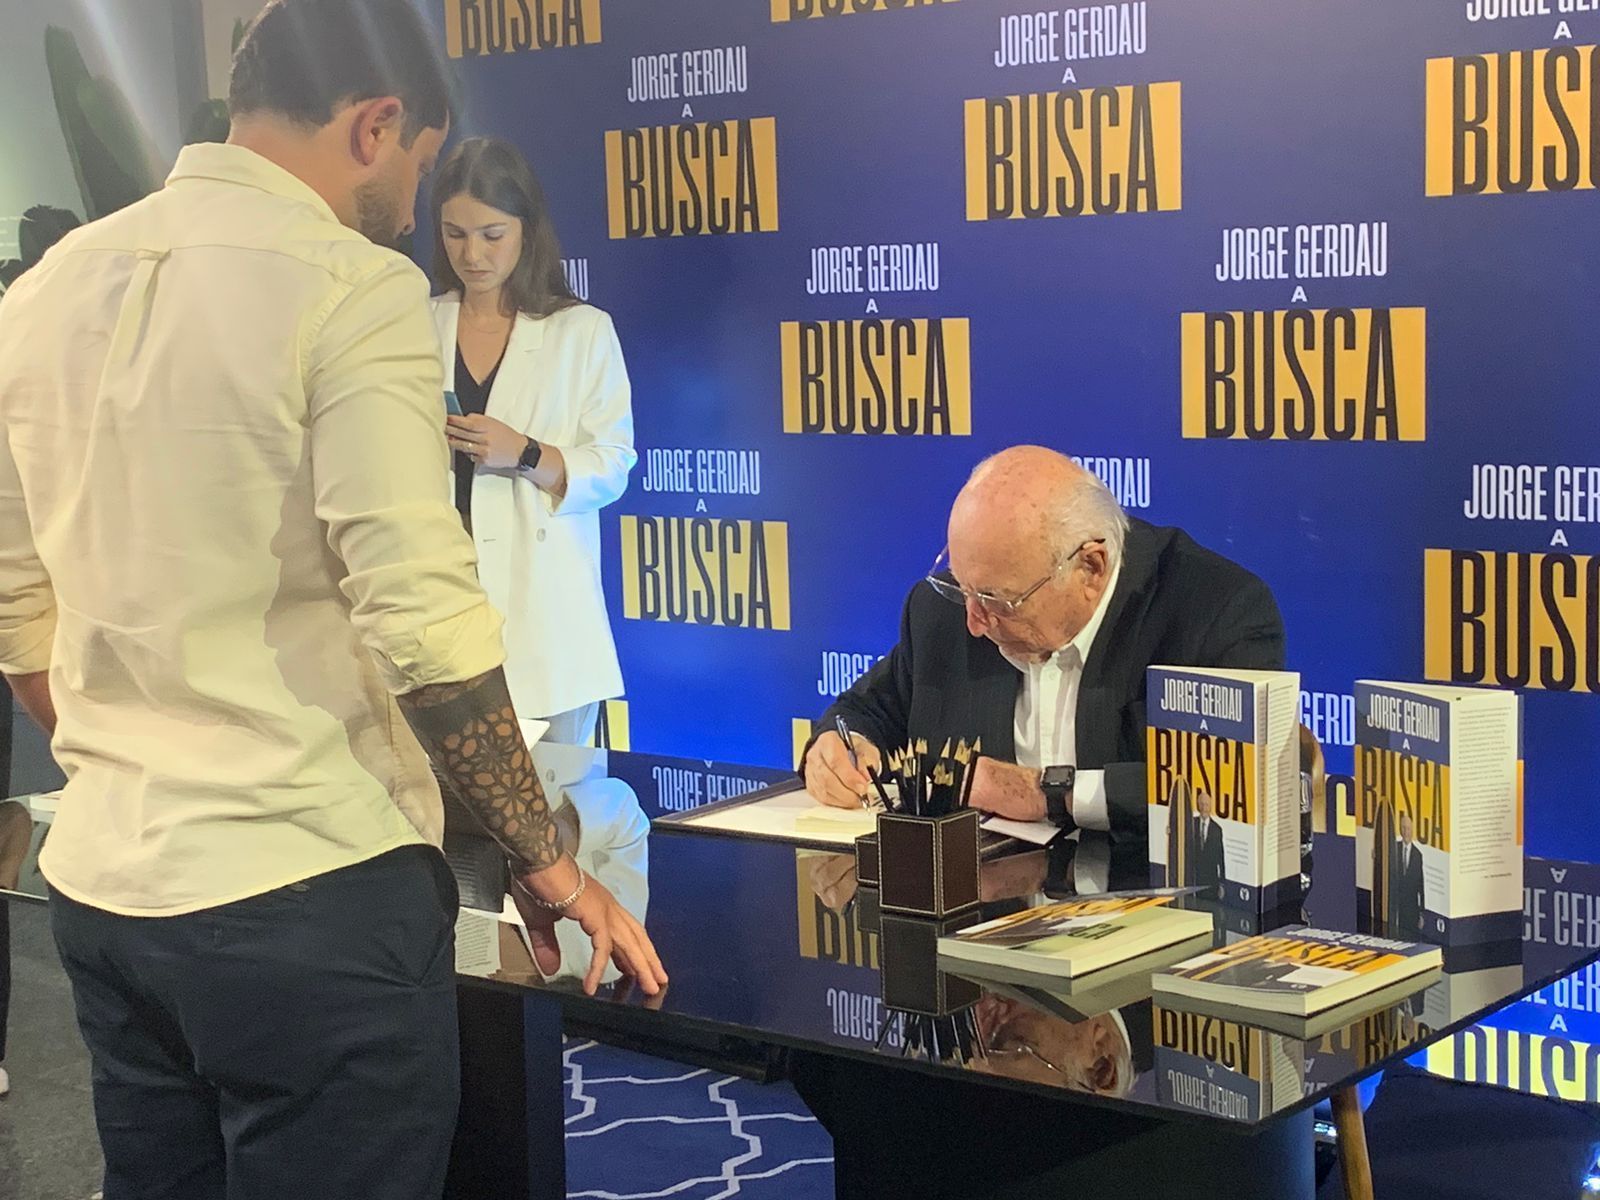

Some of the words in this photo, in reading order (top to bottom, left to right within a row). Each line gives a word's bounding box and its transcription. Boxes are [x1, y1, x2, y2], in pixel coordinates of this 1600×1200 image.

[994, 11, 1059, 67] JORGE
[1064, 1, 1147, 61] GERDAU
[1553, 21, 1572, 39] A
[627, 53, 679, 102] JORGE
[682, 46, 747, 97] GERDAU
[1062, 67, 1076, 84] A
[681, 103, 693, 118] A
[1454, 45, 1600, 195] BUS
[986, 85, 1158, 220] BUSCA
[621, 119, 760, 237] BUSCA
[806, 246, 864, 294] JORGE
[868, 243, 939, 292] GERDAU
[1216, 226, 1289, 281] JORGE
[1295, 222, 1387, 278] GERDAU
[866, 298, 878, 313] A
[1291, 286, 1308, 303] A
[799, 318, 951, 435] BUSCA
[1204, 307, 1399, 441] BUSCA
[643, 449, 694, 492] JORGE
[696, 450, 760, 495] GERDAU
[1464, 464, 1548, 520] JORGE
[696, 498, 707, 513] A
[1550, 529, 1568, 547] A
[637, 515, 772, 629] BUSCA
[1161, 678, 1199, 715] JORGE
[1201, 682, 1243, 722] GERDAU
[1200, 719, 1208, 731] A
[1367, 693, 1402, 735] JORGE
[1404, 700, 1440, 743] GERDAU
[1403, 738, 1410, 750] A
[1156, 728, 1248, 823] BUSCA
[1362, 747, 1445, 852] BUSCA
[1551, 1014, 1568, 1032] A
